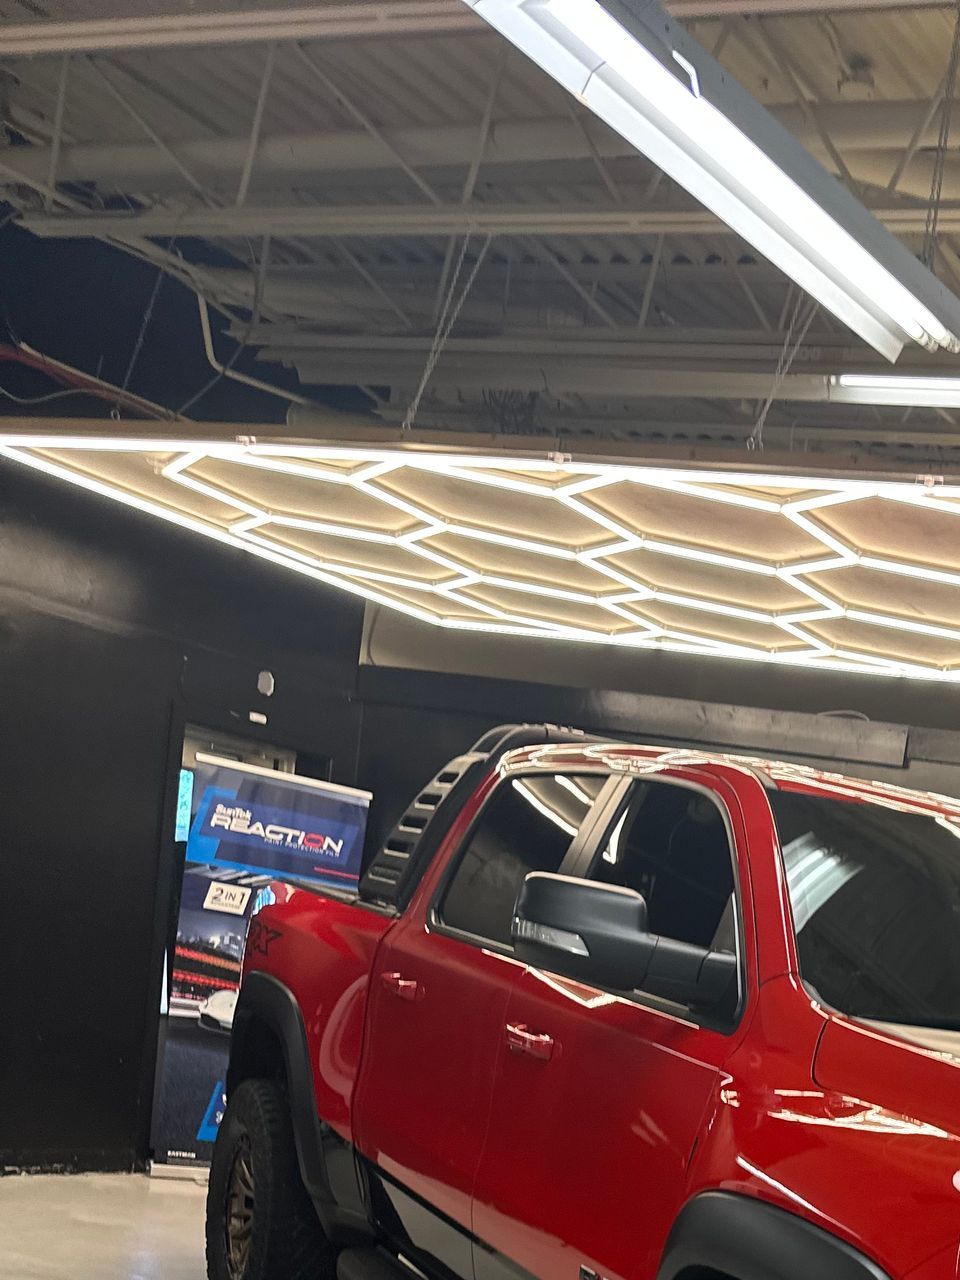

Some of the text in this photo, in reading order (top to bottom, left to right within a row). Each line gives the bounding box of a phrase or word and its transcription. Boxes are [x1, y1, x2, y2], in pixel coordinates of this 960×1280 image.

[210, 813, 343, 852] REACTION
[212, 887, 223, 901] 2
[224, 891, 237, 902] IN
[239, 891, 247, 907] 1
[167, 1150, 196, 1158] EASTMAN
